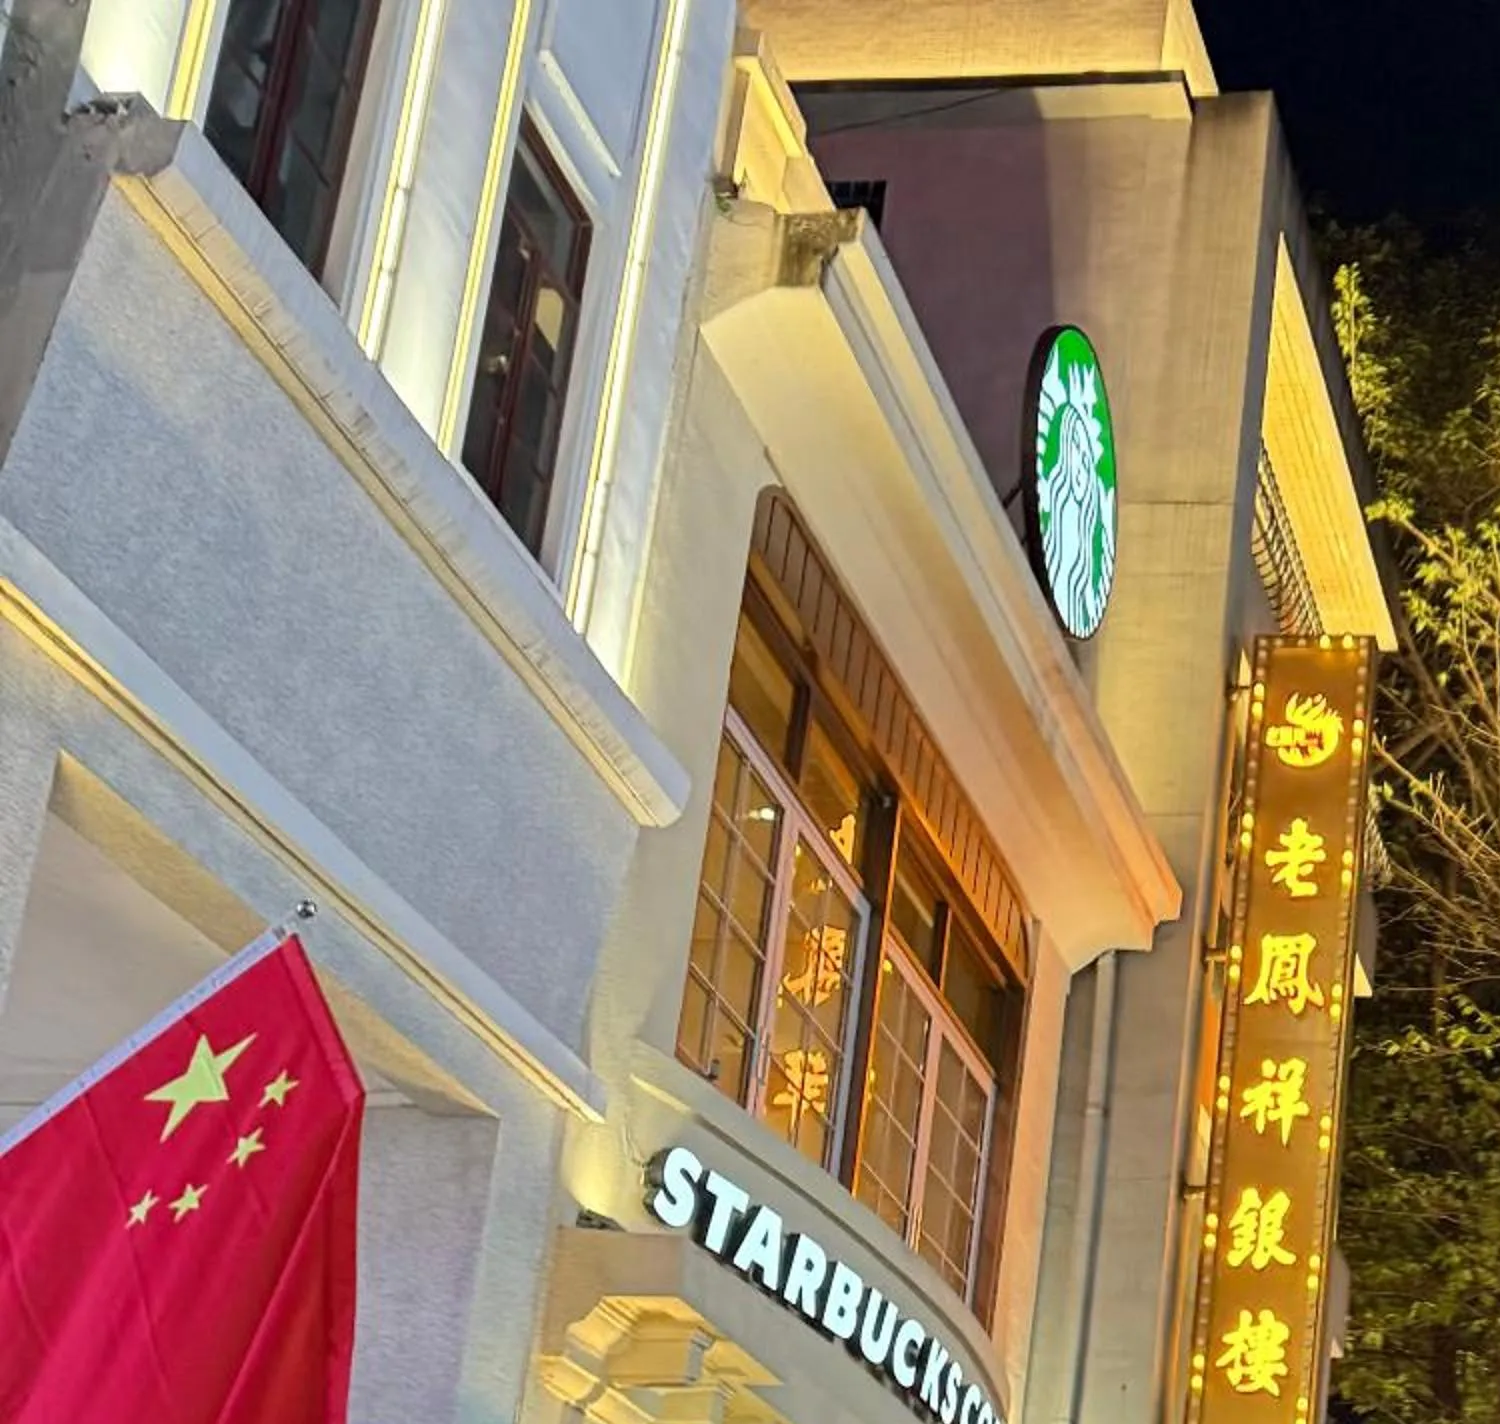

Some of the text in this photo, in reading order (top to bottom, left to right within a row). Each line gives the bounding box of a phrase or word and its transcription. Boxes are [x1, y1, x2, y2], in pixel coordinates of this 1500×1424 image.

[1215, 817, 1327, 1397] 老鳳祥銀樓
